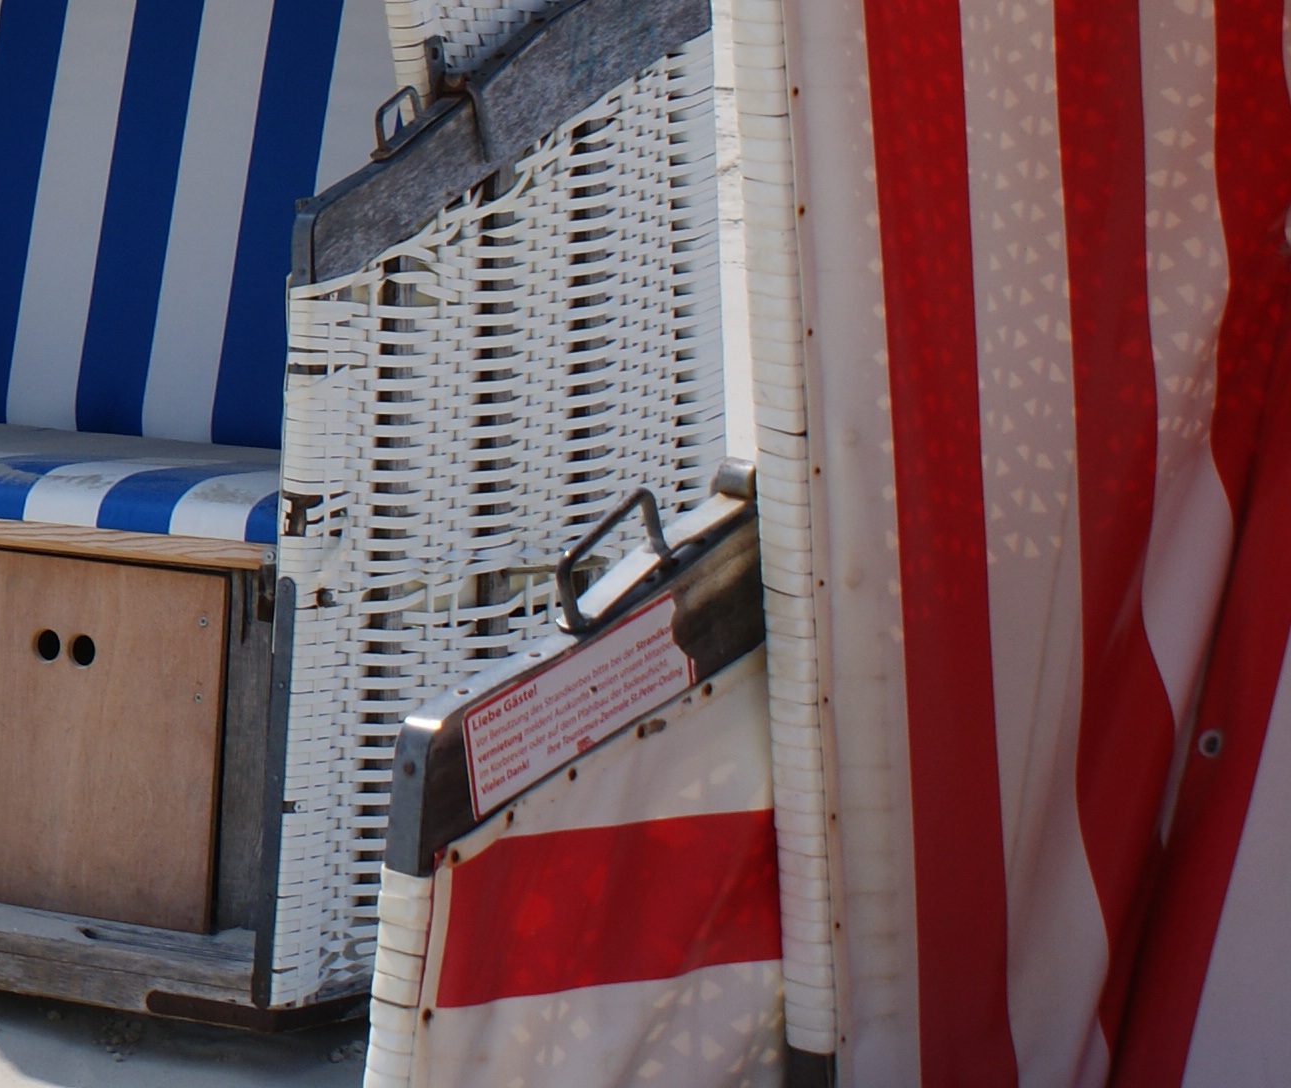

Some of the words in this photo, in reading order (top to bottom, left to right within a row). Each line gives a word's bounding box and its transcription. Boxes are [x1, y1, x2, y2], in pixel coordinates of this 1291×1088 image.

[472, 708, 501, 731] Liebe
[503, 684, 538, 712] Gäste!
[489, 711, 529, 740] Benutzung
[544, 674, 591, 707] Strandkorbes
[592, 663, 609, 678] bitte
[610, 656, 622, 667] bei
[528, 733, 546, 750] oder
[547, 722, 559, 739] auf
[609, 687, 622, 700] der
[478, 731, 523, 763] vermietung
[480, 775, 506, 795] Vielen
